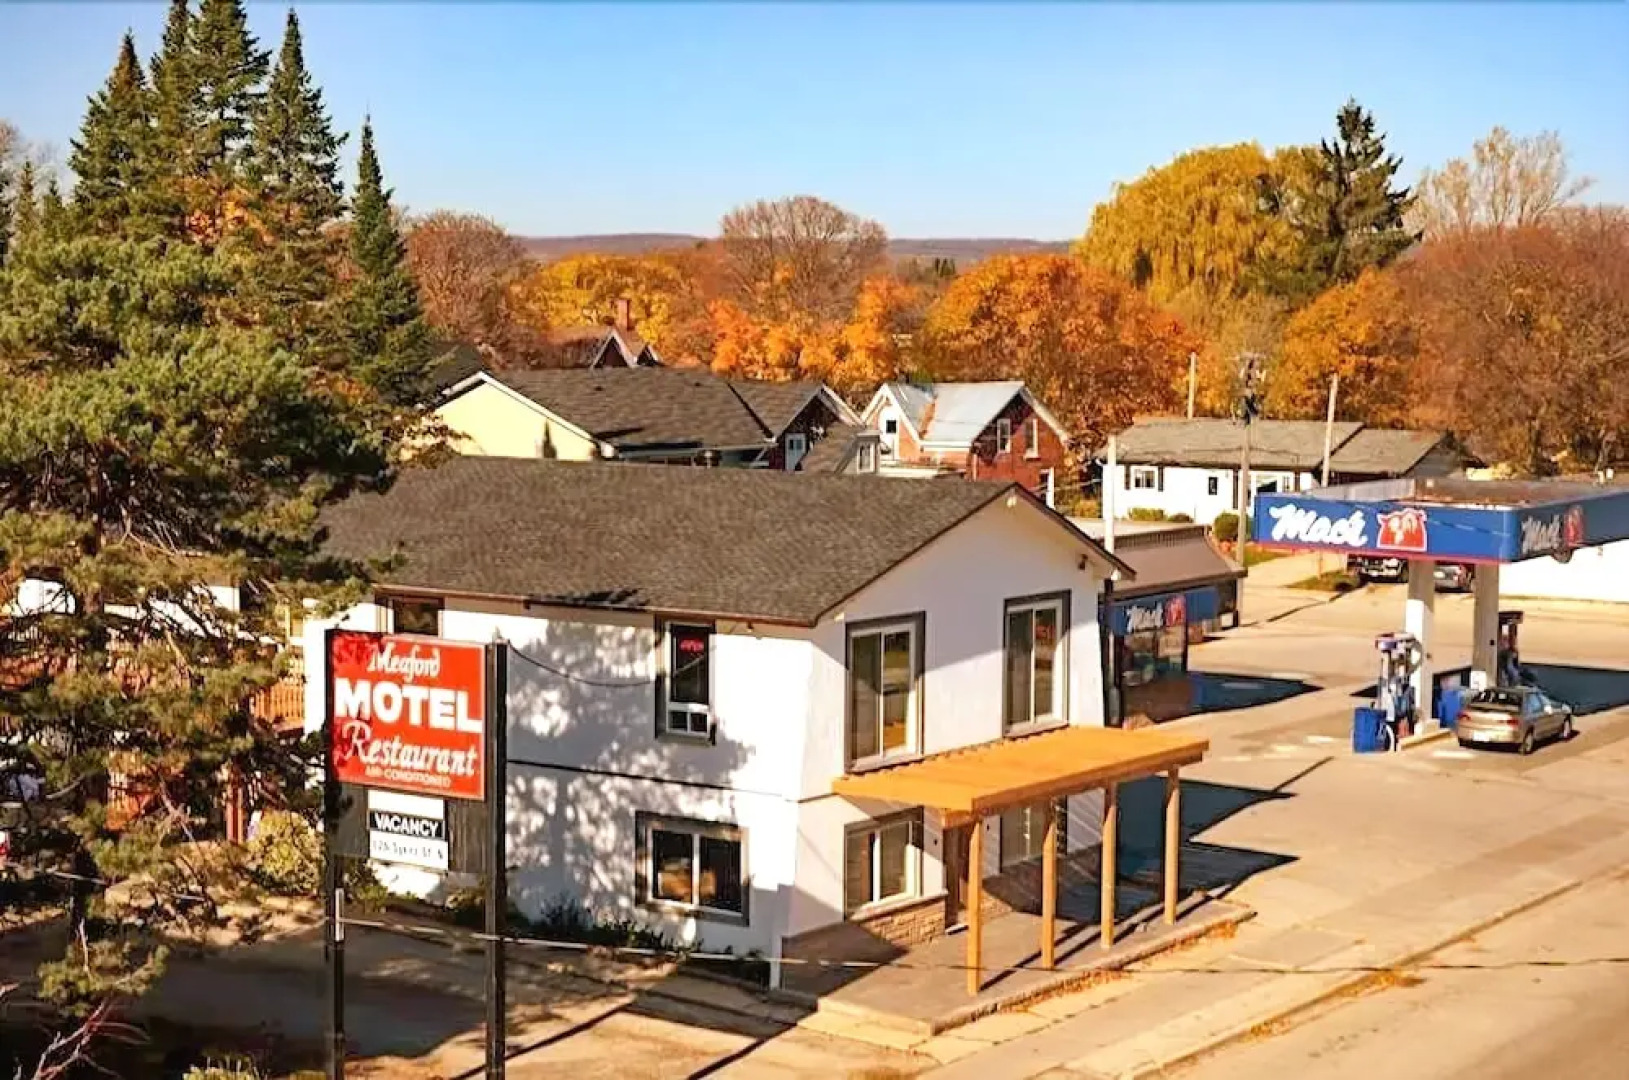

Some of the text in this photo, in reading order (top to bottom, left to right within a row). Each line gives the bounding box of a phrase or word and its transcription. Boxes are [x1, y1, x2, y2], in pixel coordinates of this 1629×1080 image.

[334, 677, 483, 733] MOTEL
[335, 720, 478, 777] Restaurant
[374, 812, 439, 837] VACANCY
